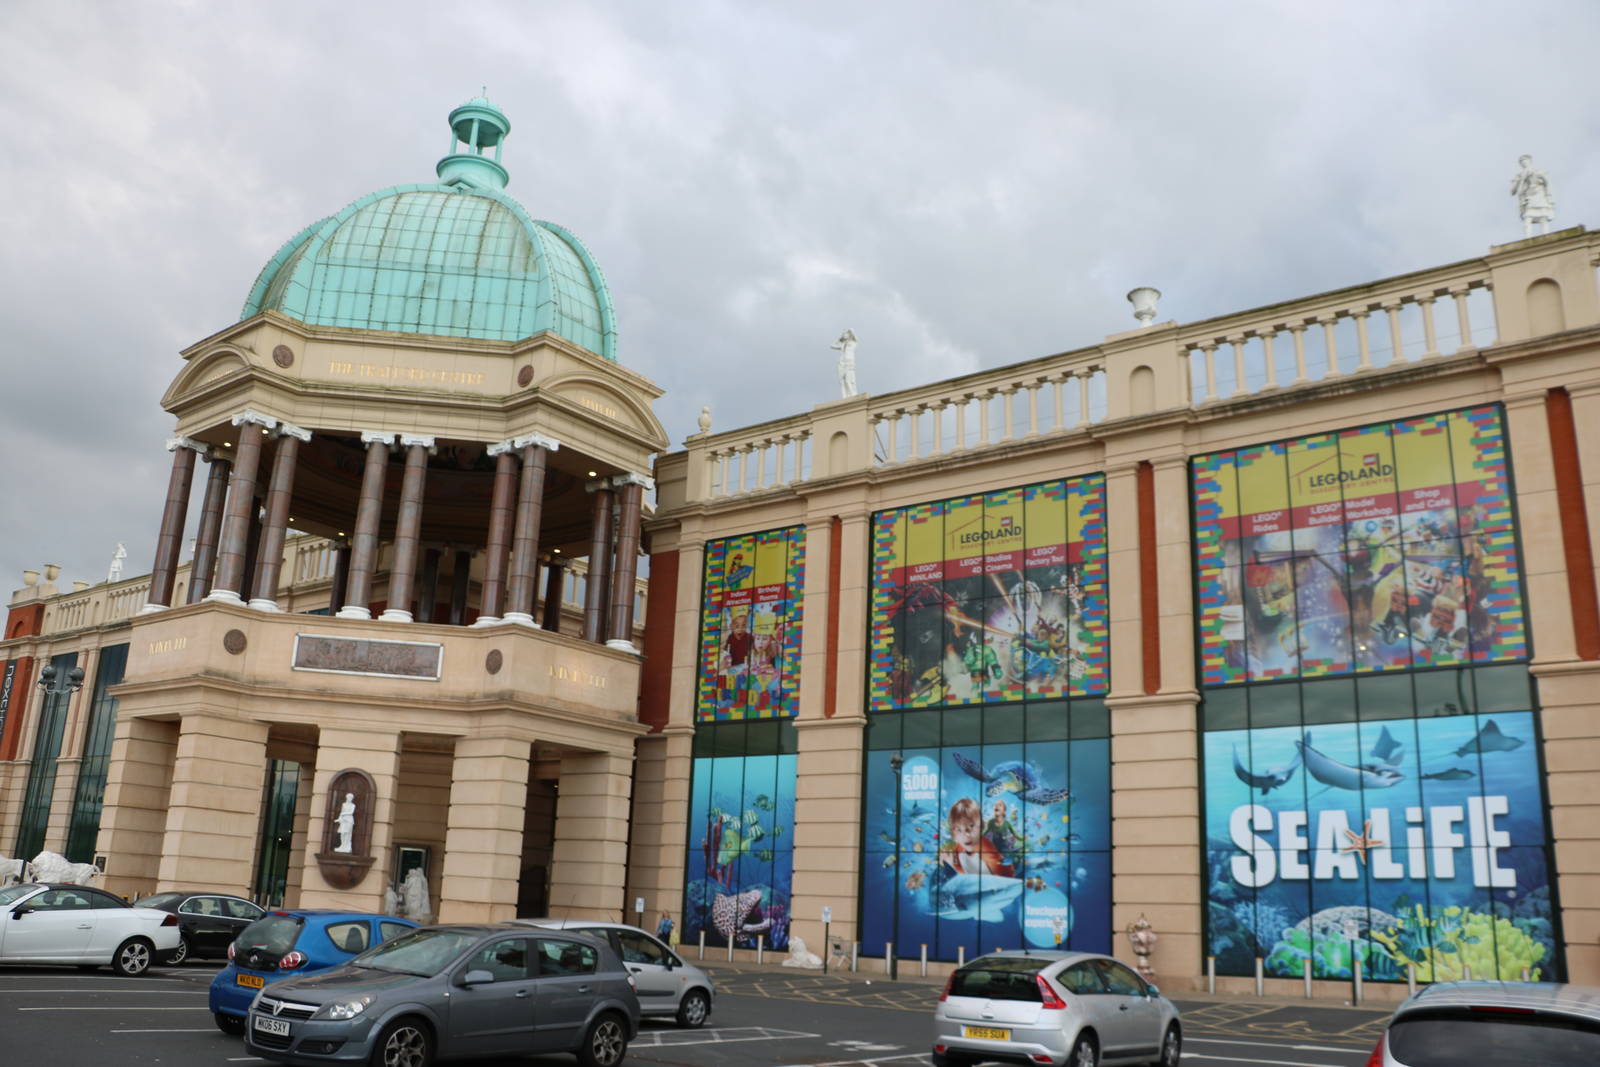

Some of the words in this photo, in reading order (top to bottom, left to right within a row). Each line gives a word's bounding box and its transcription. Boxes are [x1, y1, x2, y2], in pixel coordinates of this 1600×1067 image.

[1309, 463, 1393, 487] LEGOLAND
[1345, 498, 1376, 509] Model
[1346, 506, 1393, 519] Workshop
[960, 524, 1022, 544] LEGOLAND
[986, 553, 1012, 563] Studios
[1025, 557, 1050, 567] Factory
[985, 562, 1013, 572] Cinema
[909, 571, 943, 582] MINILAND
[1229, 804, 1360, 888] SEA
[273, 1021, 287, 1033] SXY
